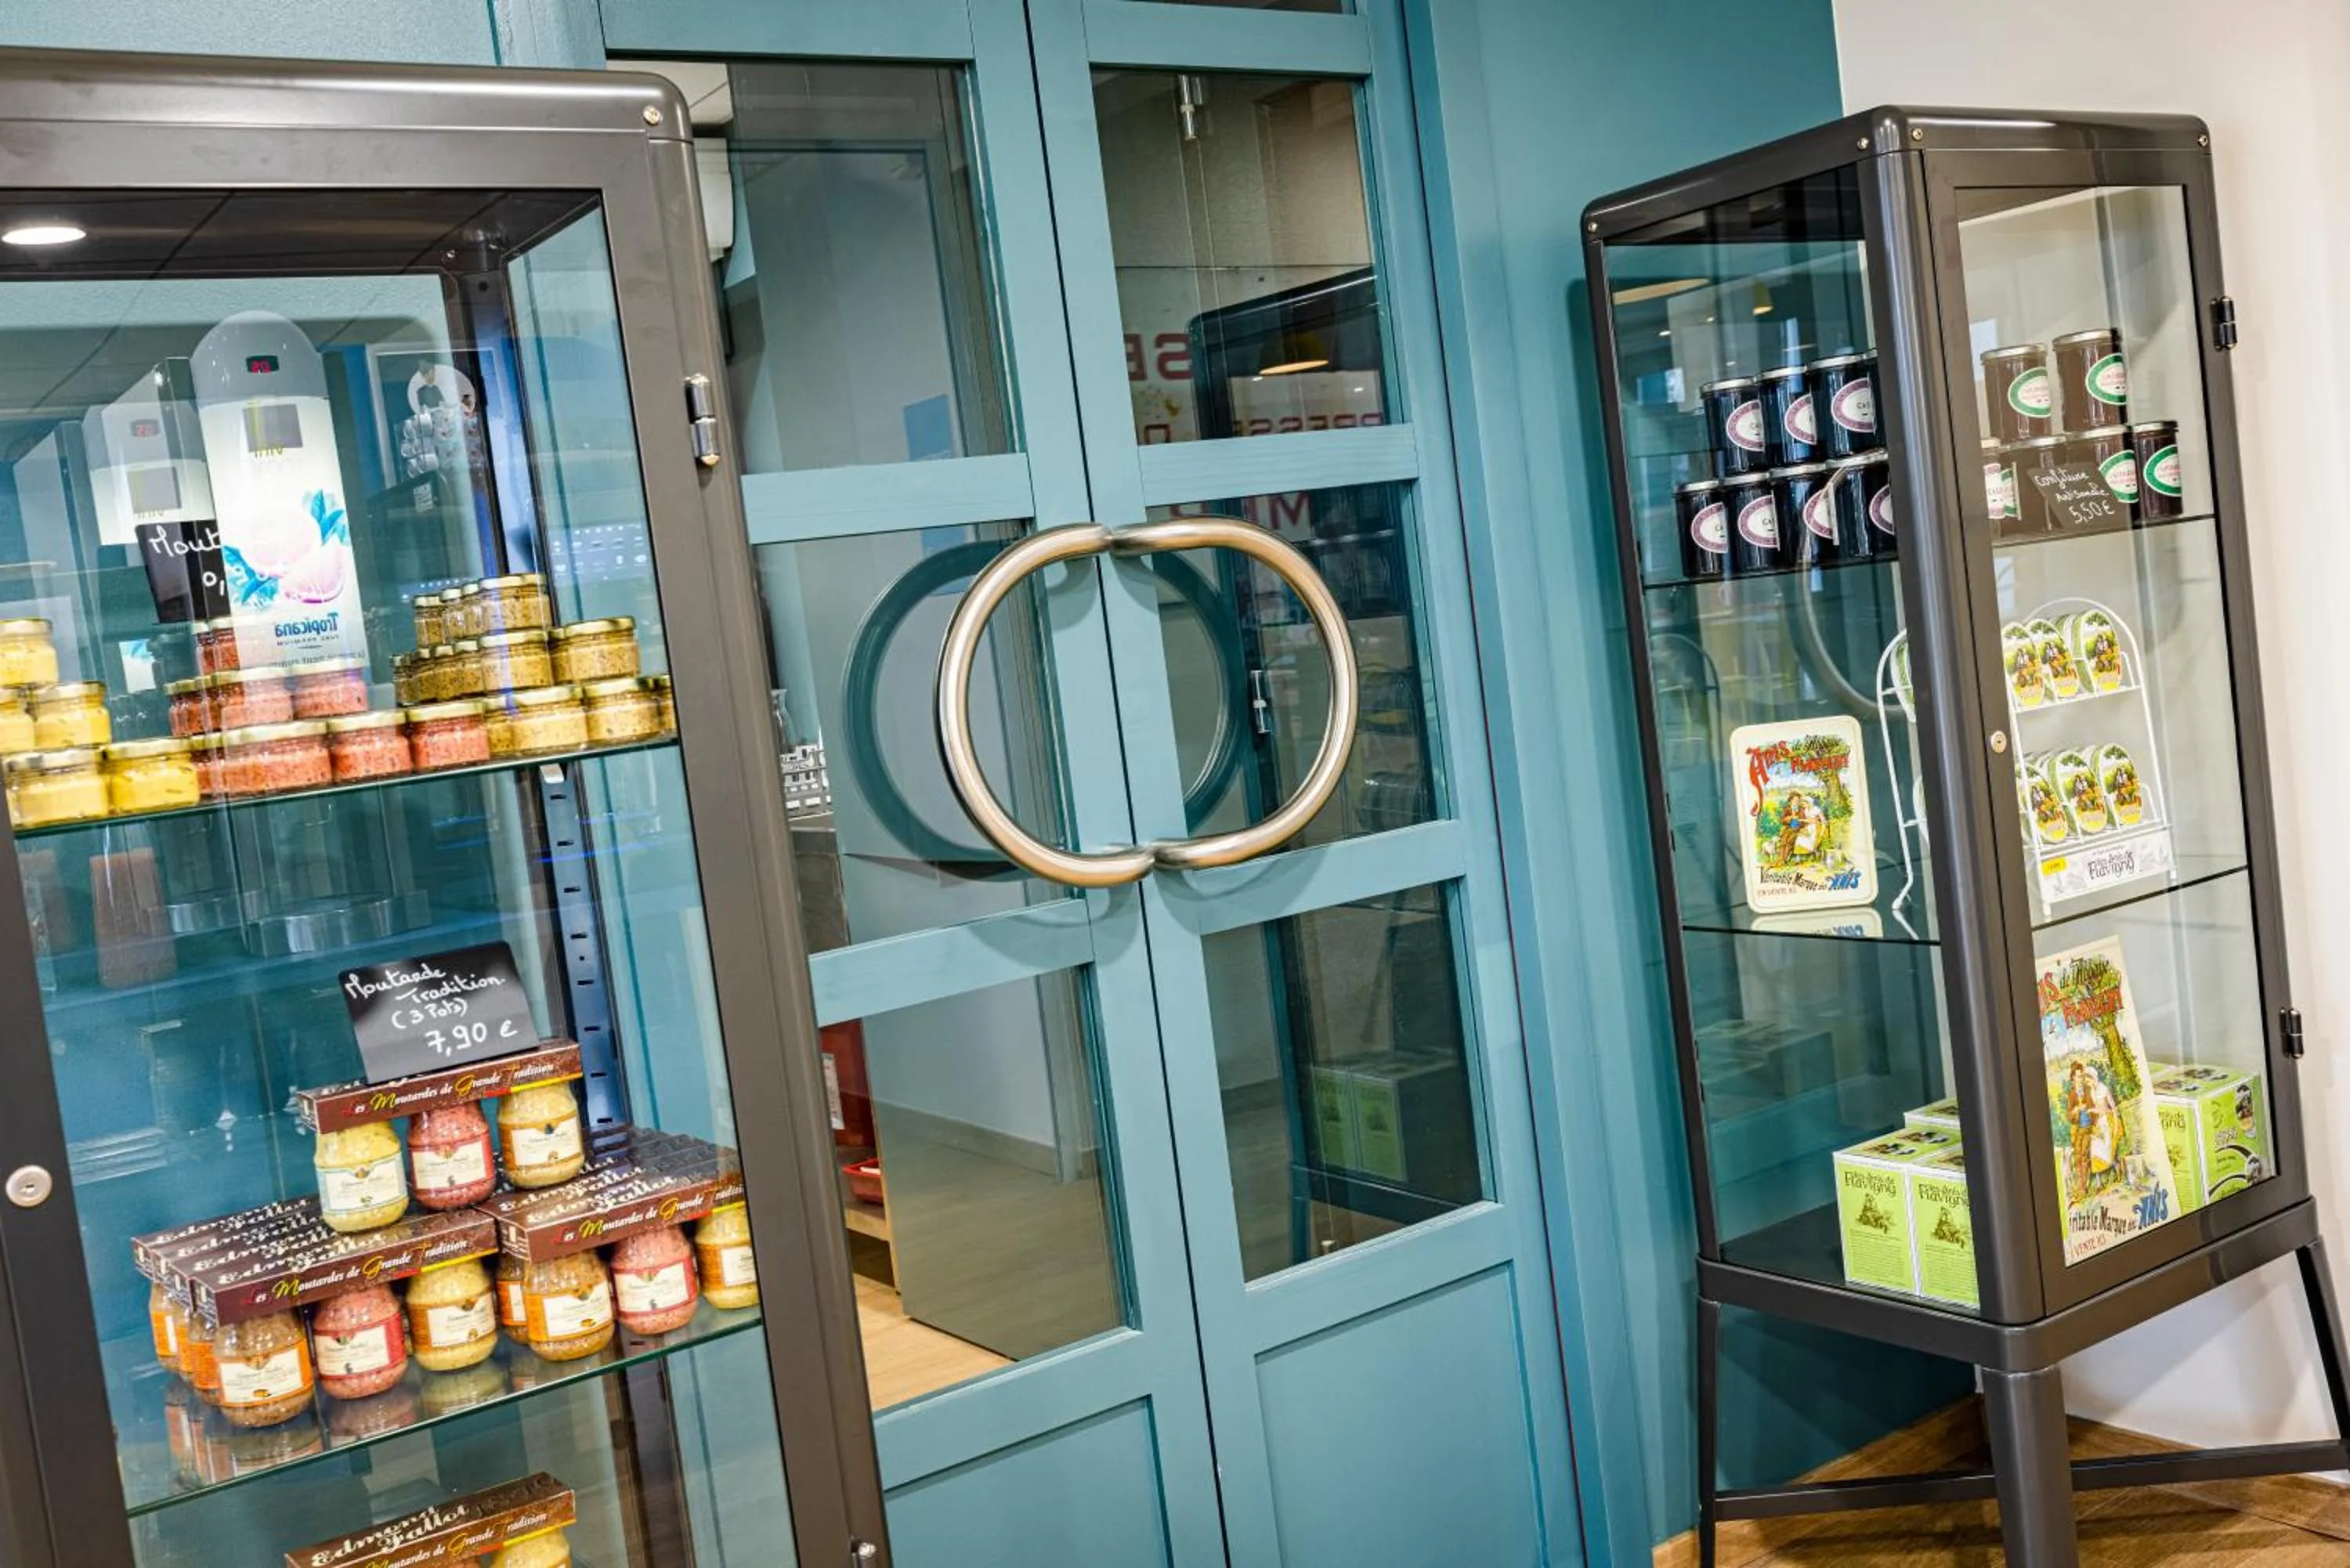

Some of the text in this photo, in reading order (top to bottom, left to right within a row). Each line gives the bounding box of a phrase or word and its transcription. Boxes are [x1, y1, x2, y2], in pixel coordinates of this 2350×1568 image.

[345, 963, 446, 999] Moutarde
[425, 1022, 487, 1056] 7,90
[370, 1085, 438, 1111] Moutardes
[439, 1083, 454, 1094] de
[455, 1073, 501, 1097] Grande
[580, 1212, 644, 1239] Moutardes
[645, 1207, 659, 1219] de
[659, 1197, 704, 1219] Grande
[271, 1272, 344, 1300] Moutardes
[347, 1266, 360, 1279] de
[363, 1253, 411, 1277] Grande
[414, 1241, 468, 1266] Tradition
[312, 1507, 439, 1567] Edmond
[378, 1505, 469, 1554] Fallot
[432, 1544, 446, 1557] de
[448, 1528, 495, 1553] Grande
